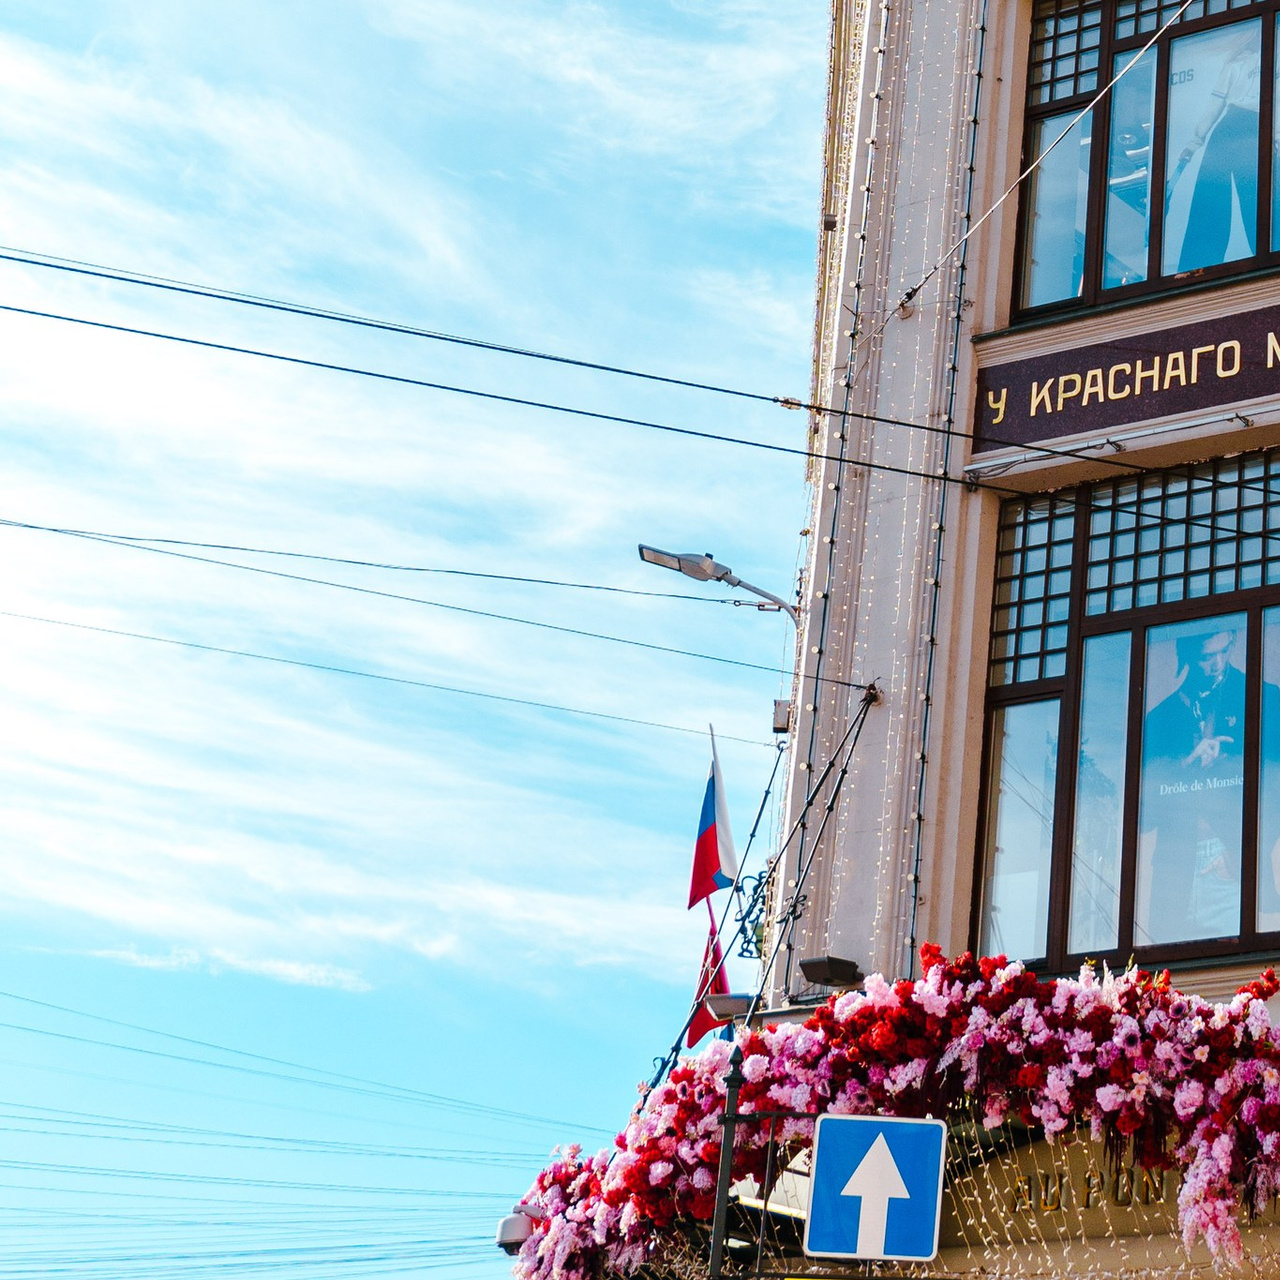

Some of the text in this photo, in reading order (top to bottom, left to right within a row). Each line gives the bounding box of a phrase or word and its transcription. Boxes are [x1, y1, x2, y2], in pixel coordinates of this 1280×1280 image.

[988, 388, 1008, 424] У
[1029, 339, 1242, 417] КРАСНАГО
[1160, 781, 1188, 795] Drôle
[1190, 779, 1203, 791] de
